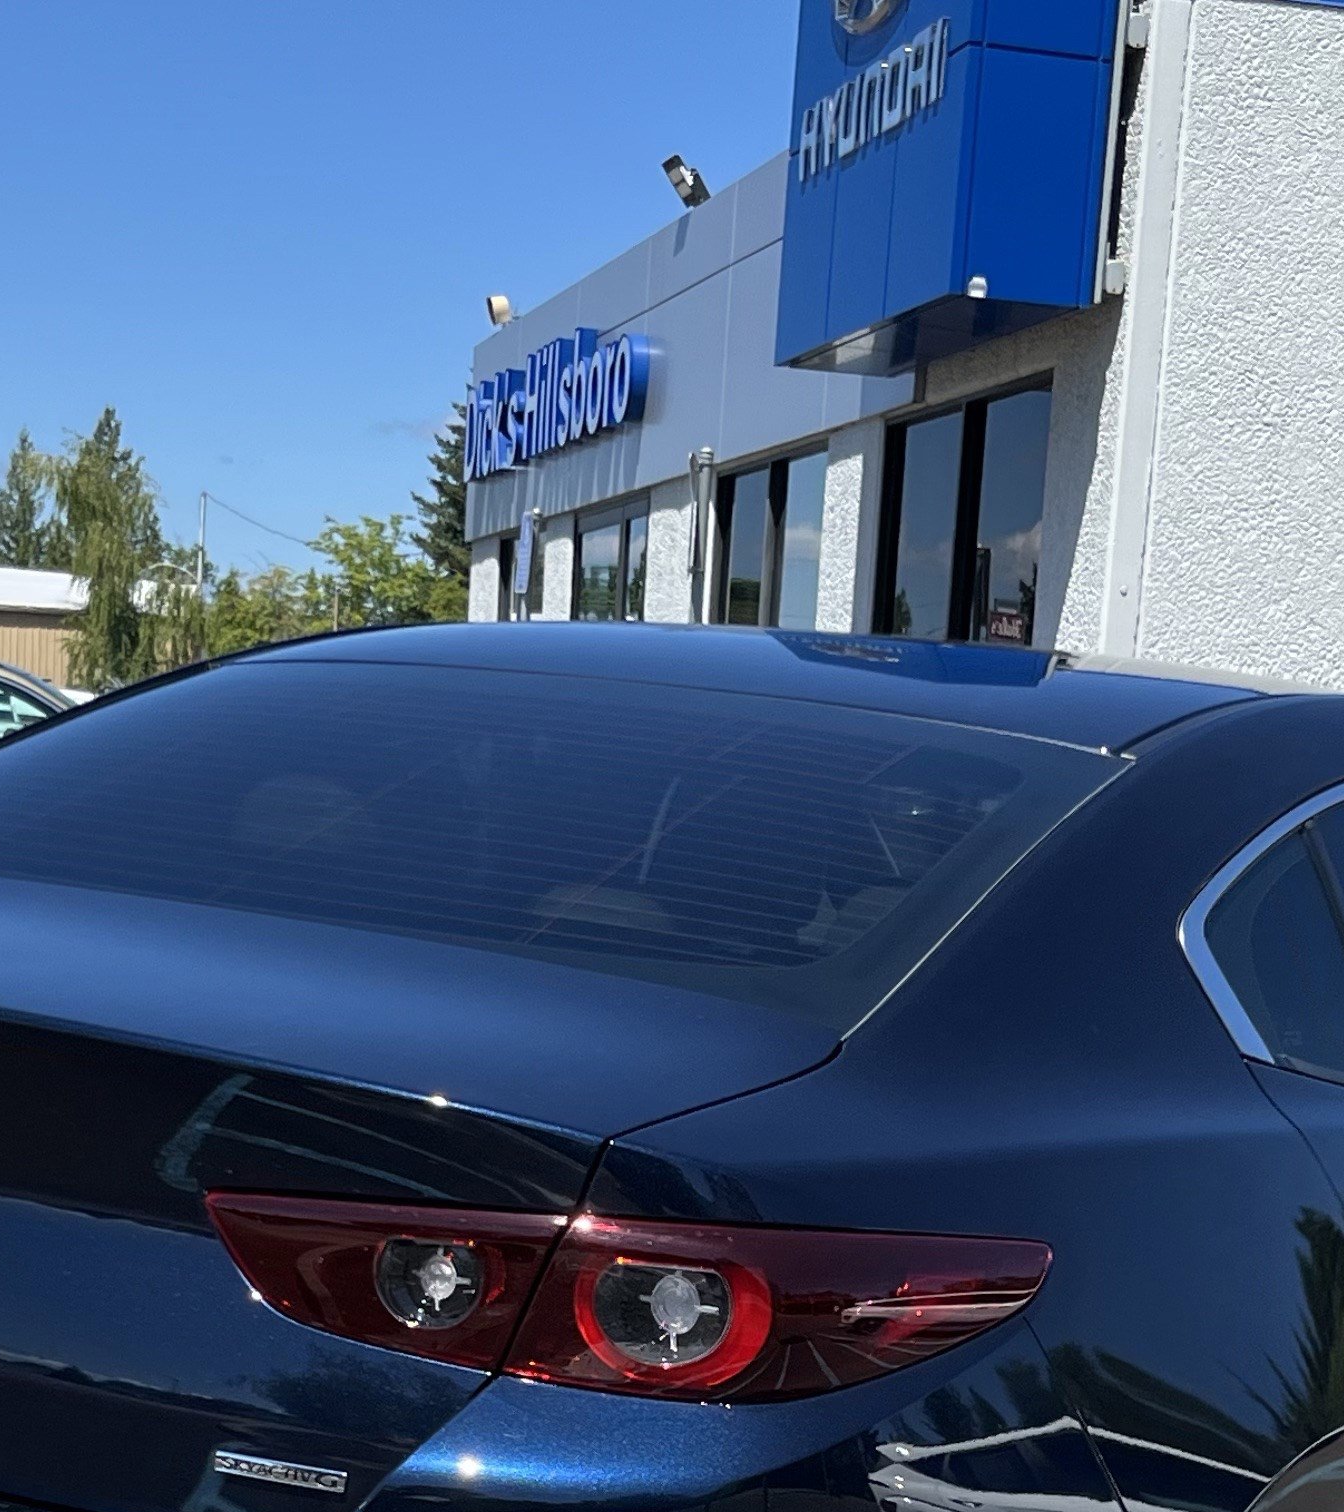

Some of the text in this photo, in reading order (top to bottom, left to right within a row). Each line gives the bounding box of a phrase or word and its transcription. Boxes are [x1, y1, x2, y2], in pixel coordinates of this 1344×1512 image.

[799, 16, 950, 182] HYUNDAI
[463, 327, 639, 483] Dick's Hillsboro
